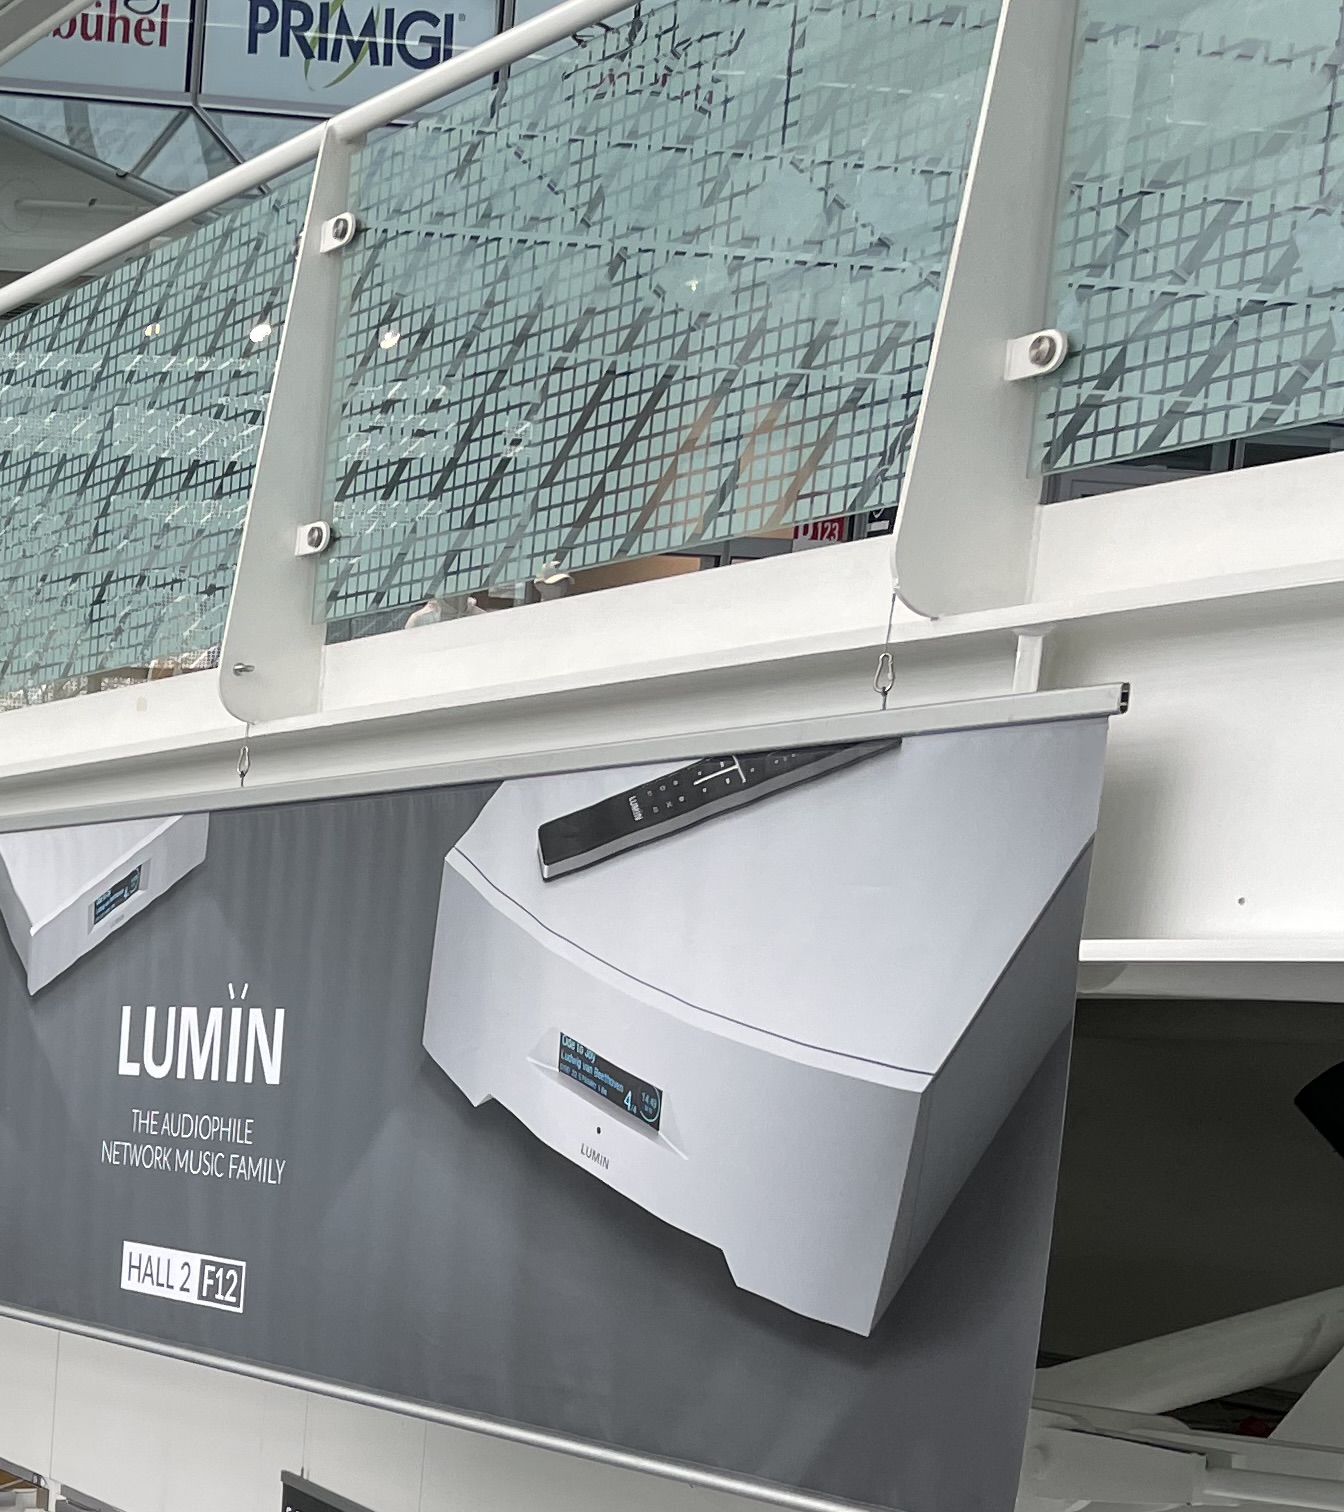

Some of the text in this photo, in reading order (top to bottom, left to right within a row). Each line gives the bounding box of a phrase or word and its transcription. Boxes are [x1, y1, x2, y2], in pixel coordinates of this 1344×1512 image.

[247, 0, 455, 70] PRIMIGI
[132, 1108, 254, 1145] THE AUDIOPHILE
[101, 1140, 287, 1185] NETWORK MUSIC FAMILY
[580, 1143, 610, 1170] LUMIN
[128, 1251, 238, 1303] HALL 2 F12
